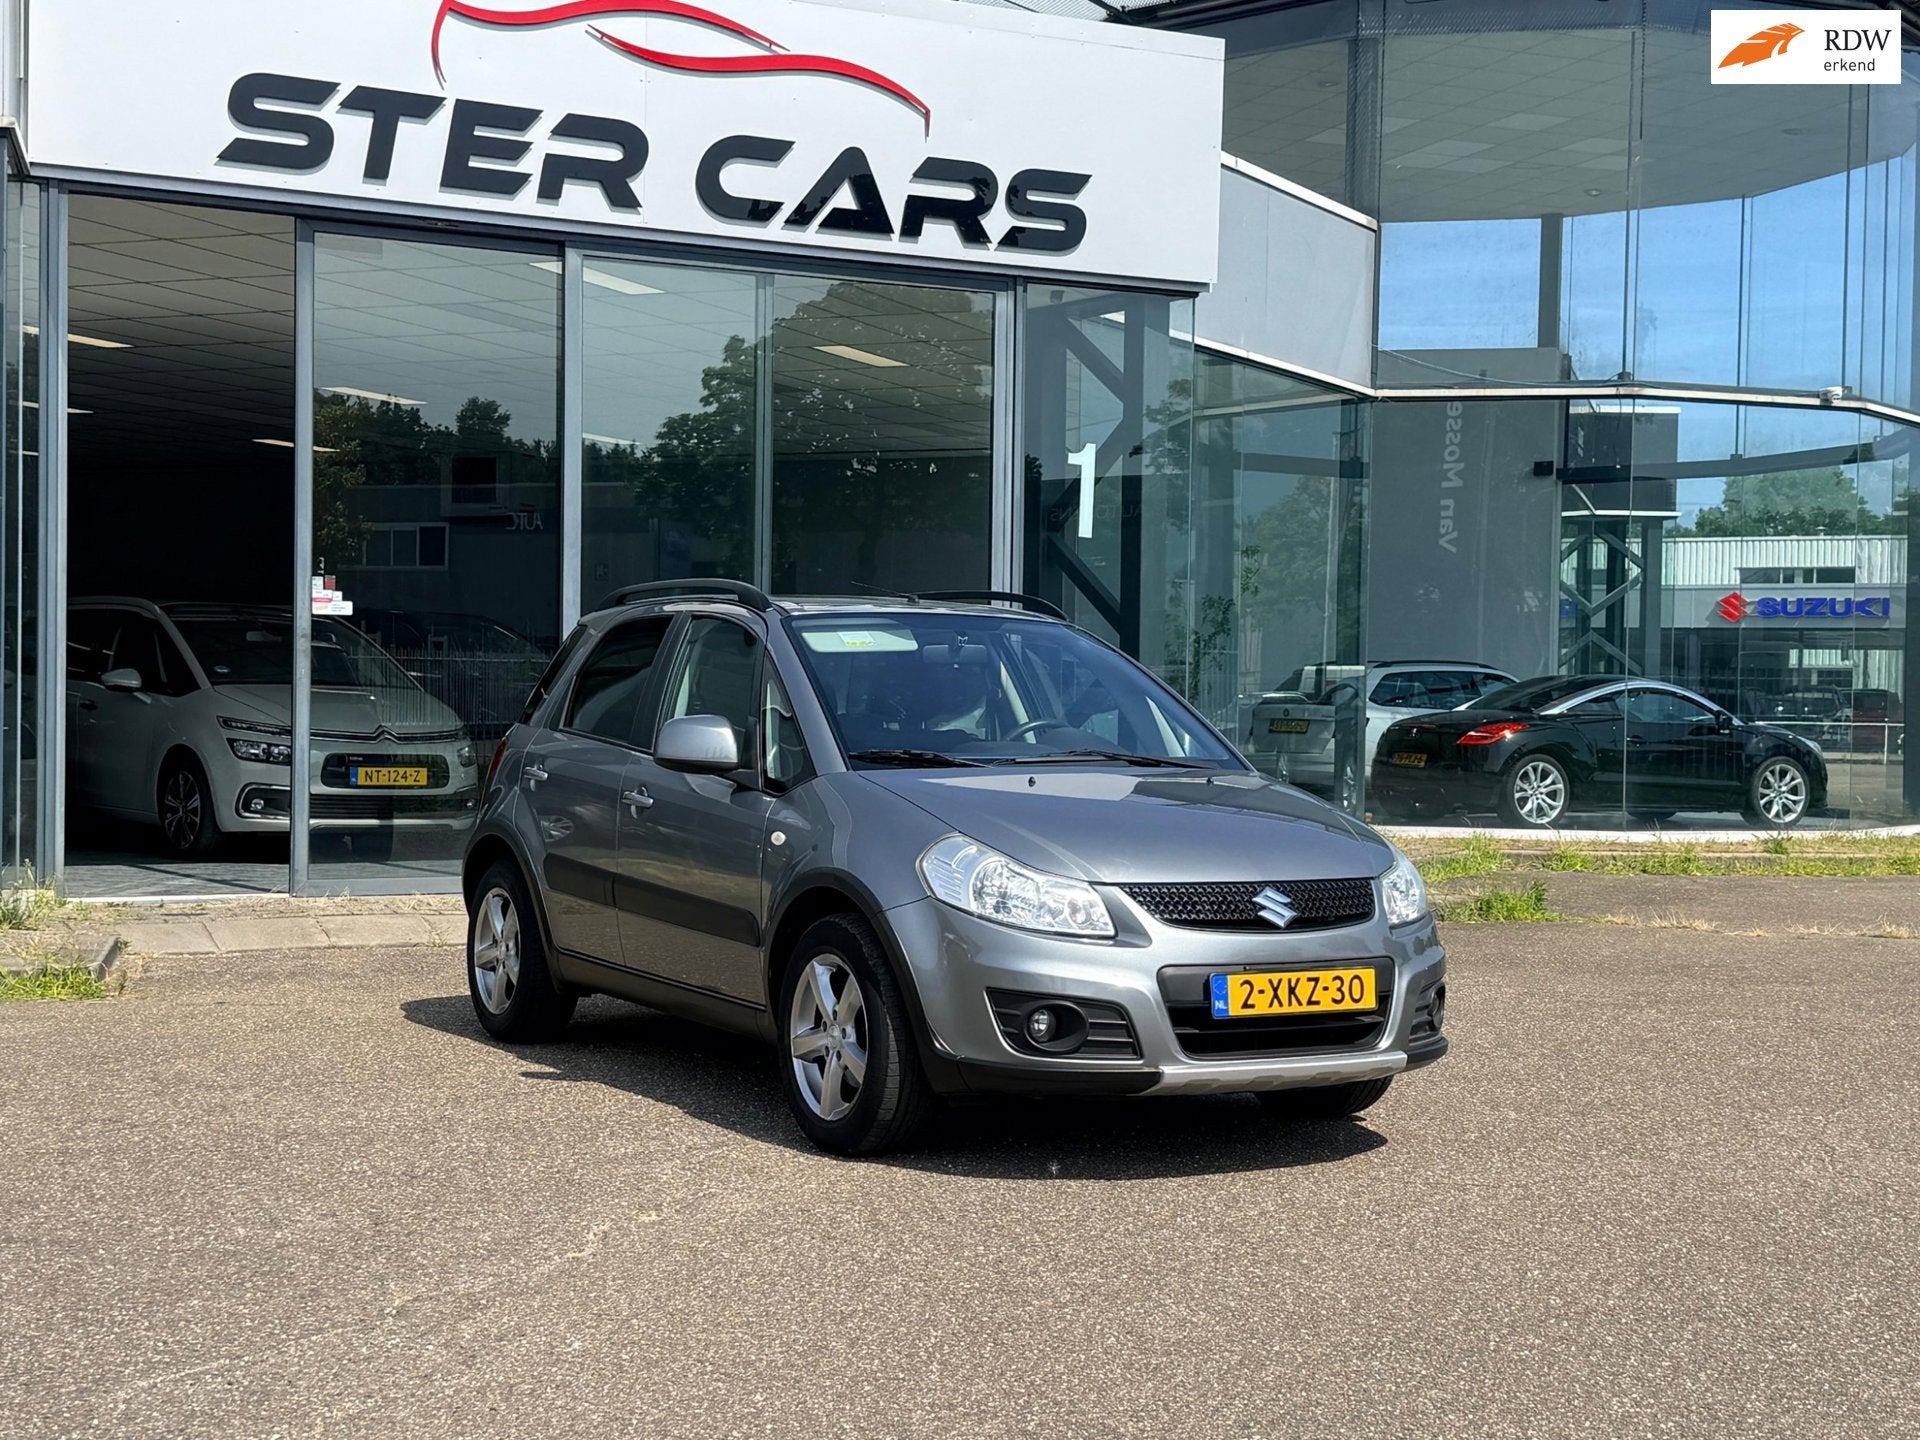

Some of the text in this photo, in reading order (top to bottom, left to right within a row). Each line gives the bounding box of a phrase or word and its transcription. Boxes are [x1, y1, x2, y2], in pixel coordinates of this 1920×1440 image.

[216, 72, 1093, 254] STER CARS
[1067, 442, 1097, 539] 1
[1755, 596, 1891, 618] SUZUKI
[364, 769, 421, 783] NT-124-Z
[1215, 973, 1365, 1010] NL 2-XKZ-30
